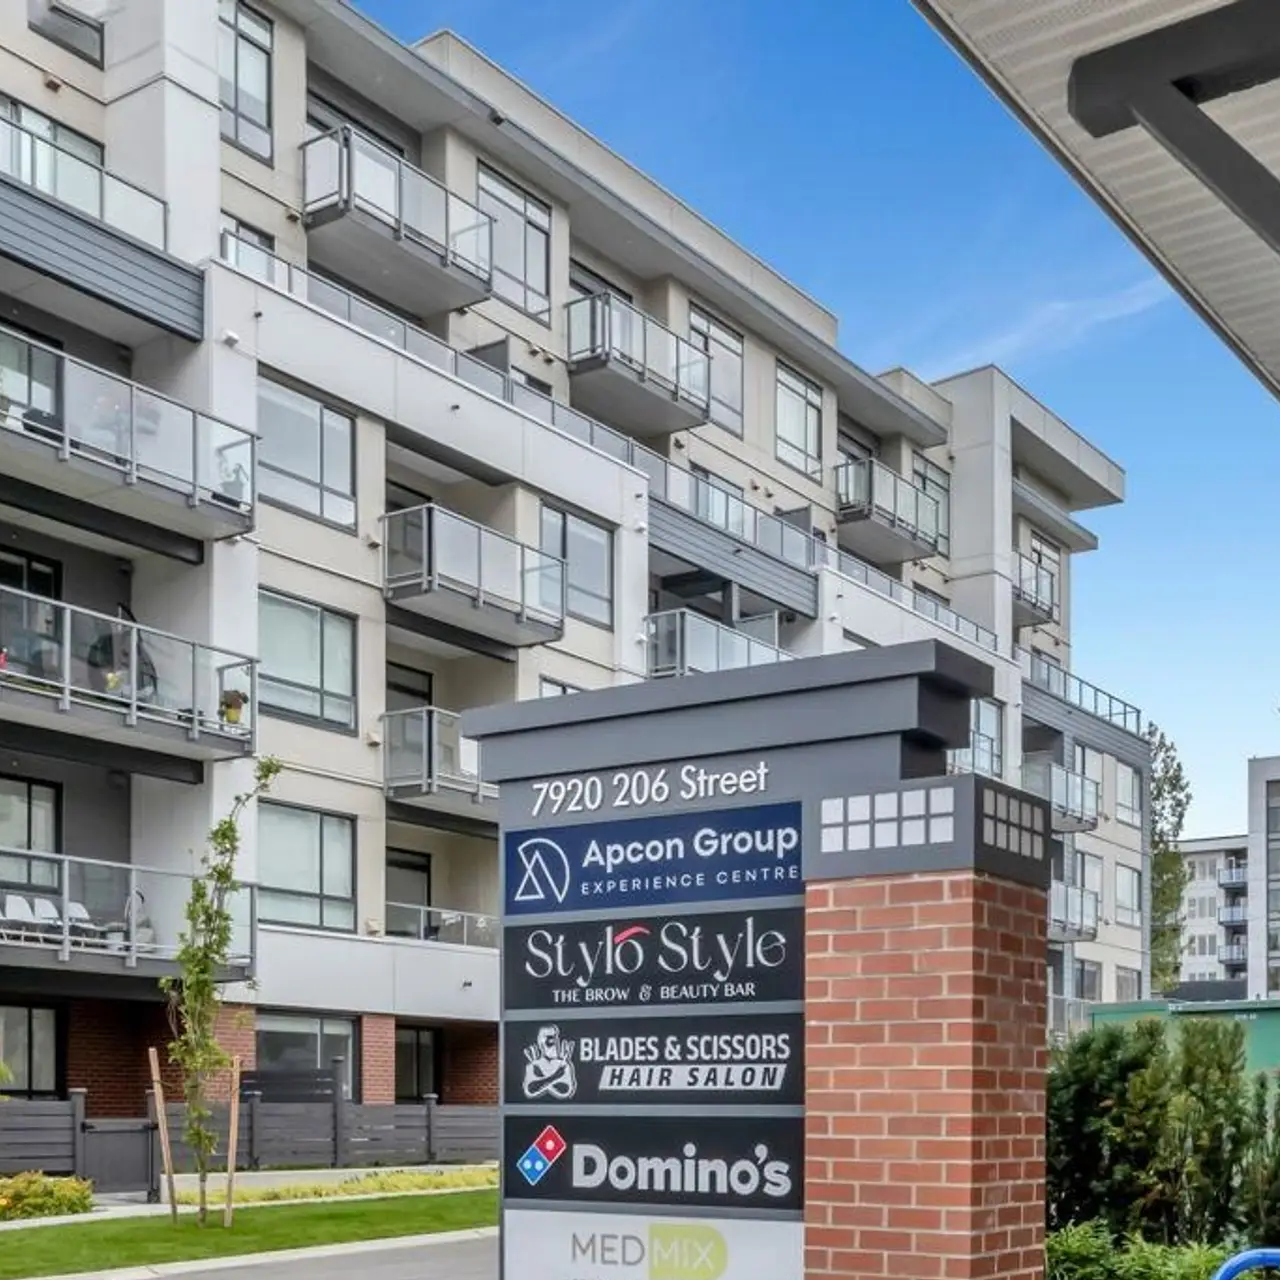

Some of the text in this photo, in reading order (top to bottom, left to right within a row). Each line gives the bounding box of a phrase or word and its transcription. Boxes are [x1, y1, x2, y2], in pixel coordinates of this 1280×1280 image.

[531, 761, 770, 817] 7920 206 Street
[581, 827, 800, 873] Apcon Group
[581, 865, 799, 896] EXPERIENCE CENTRE
[657, 916, 787, 982] Style
[552, 981, 756, 1003] THE BROW & BEAUTY BAR
[579, 1033, 791, 1063] BLADES & SCISSORS
[608, 1066, 779, 1088] HAIR SALON
[572, 1142, 792, 1198] Domino's
